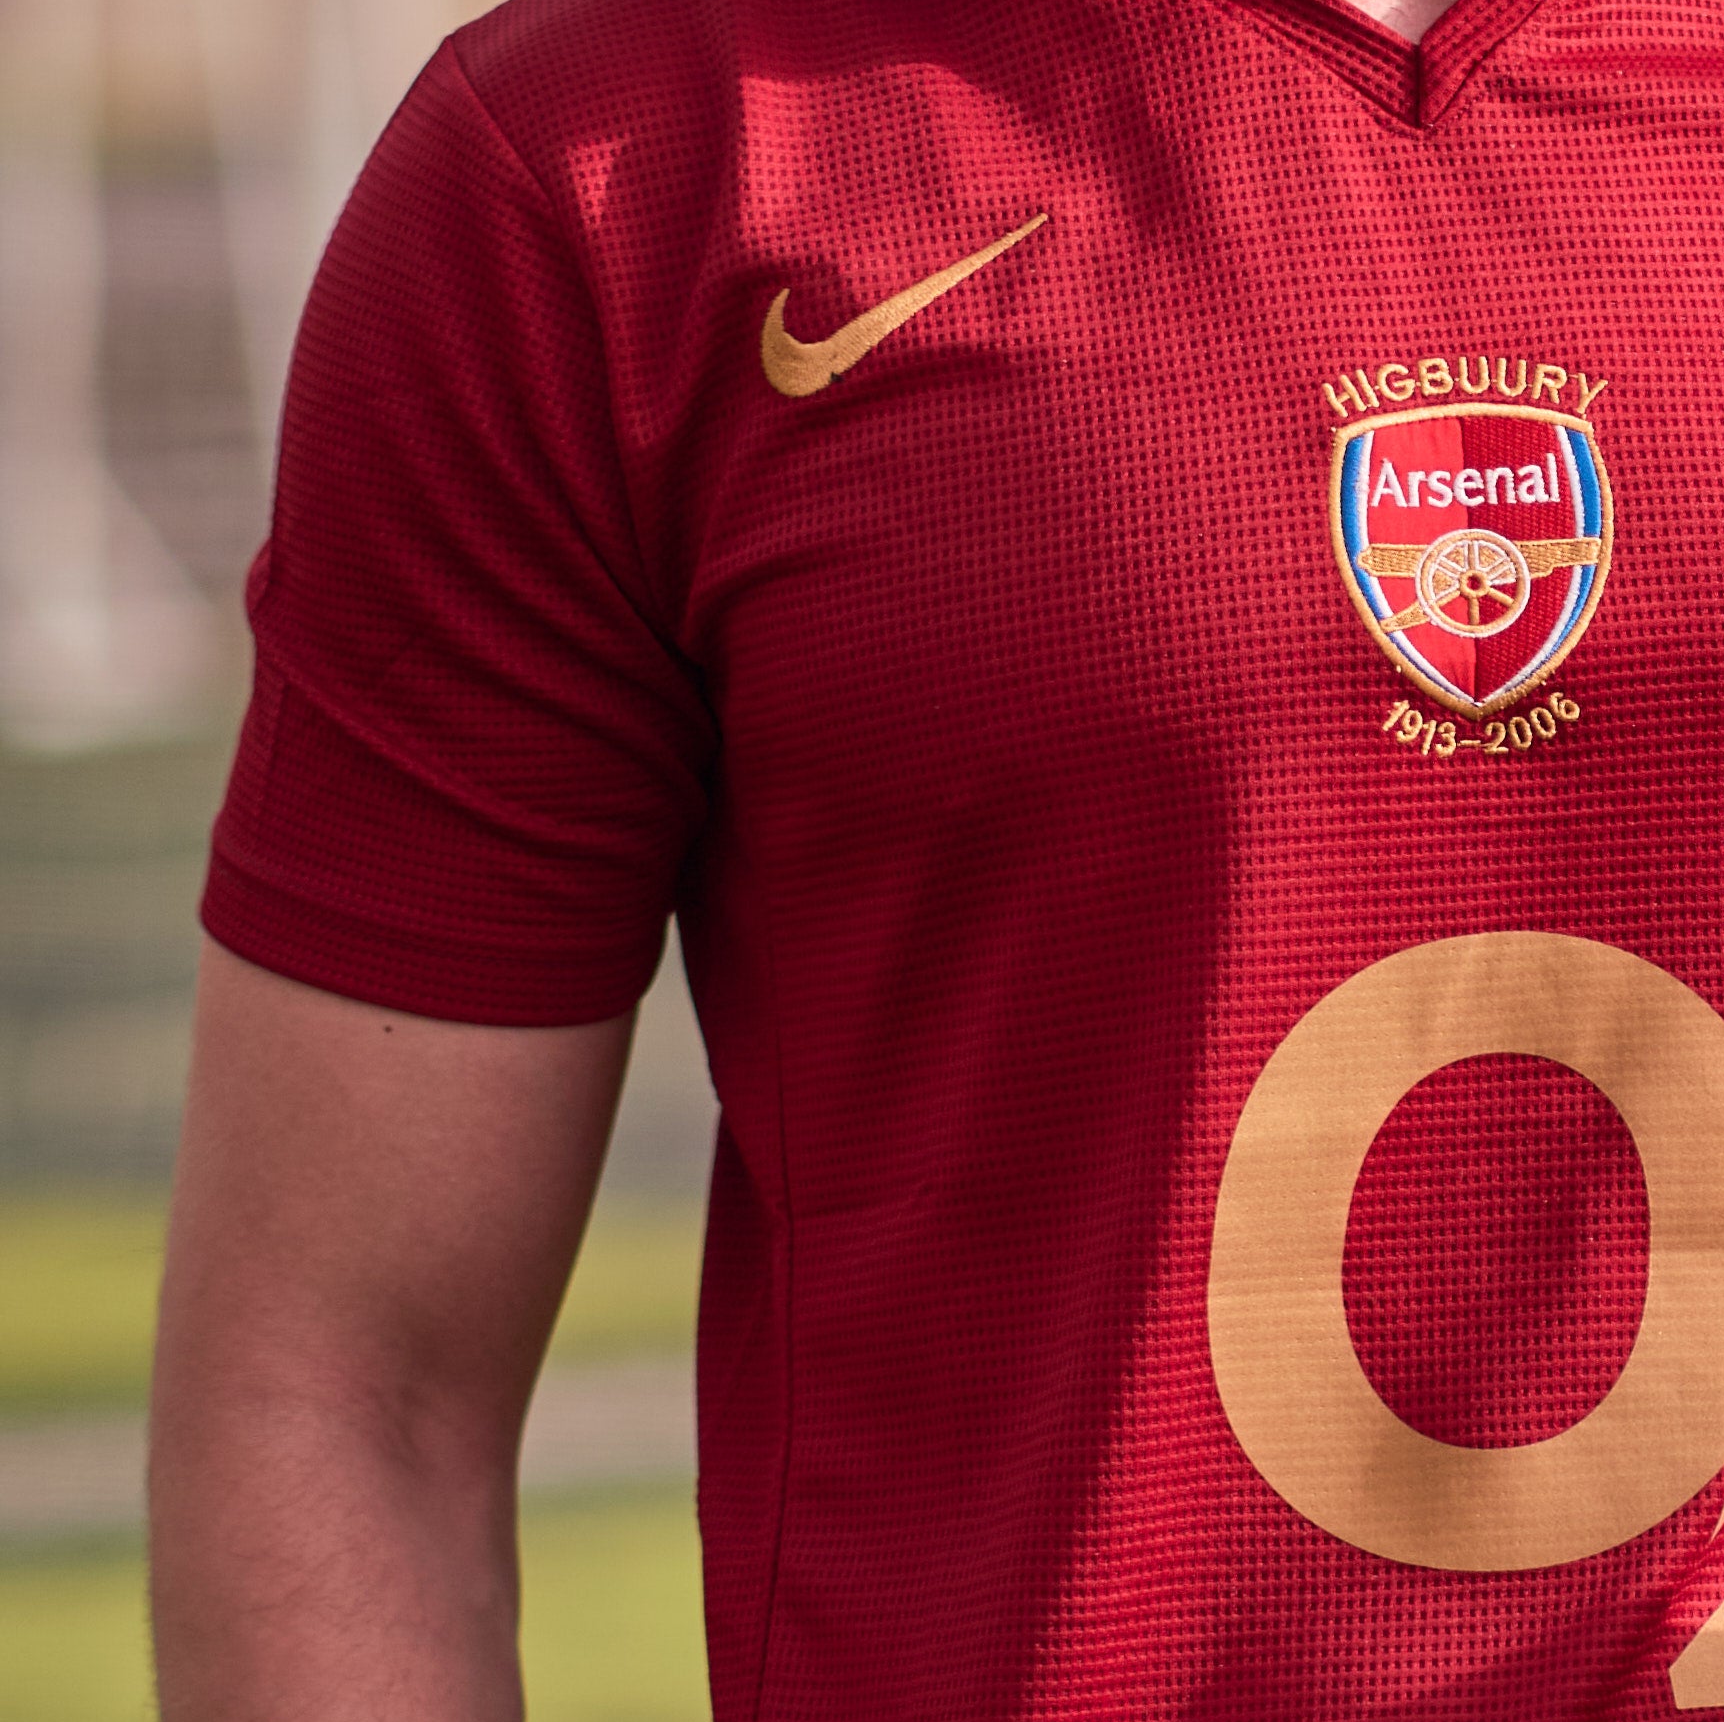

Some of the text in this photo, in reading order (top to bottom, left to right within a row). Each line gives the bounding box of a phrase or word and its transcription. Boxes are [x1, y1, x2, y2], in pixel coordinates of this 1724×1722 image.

[1321, 355, 1608, 418] HIGBUURY
[1370, 452, 1561, 508] Arsenal
[1382, 691, 1580, 758] 1913-2006
